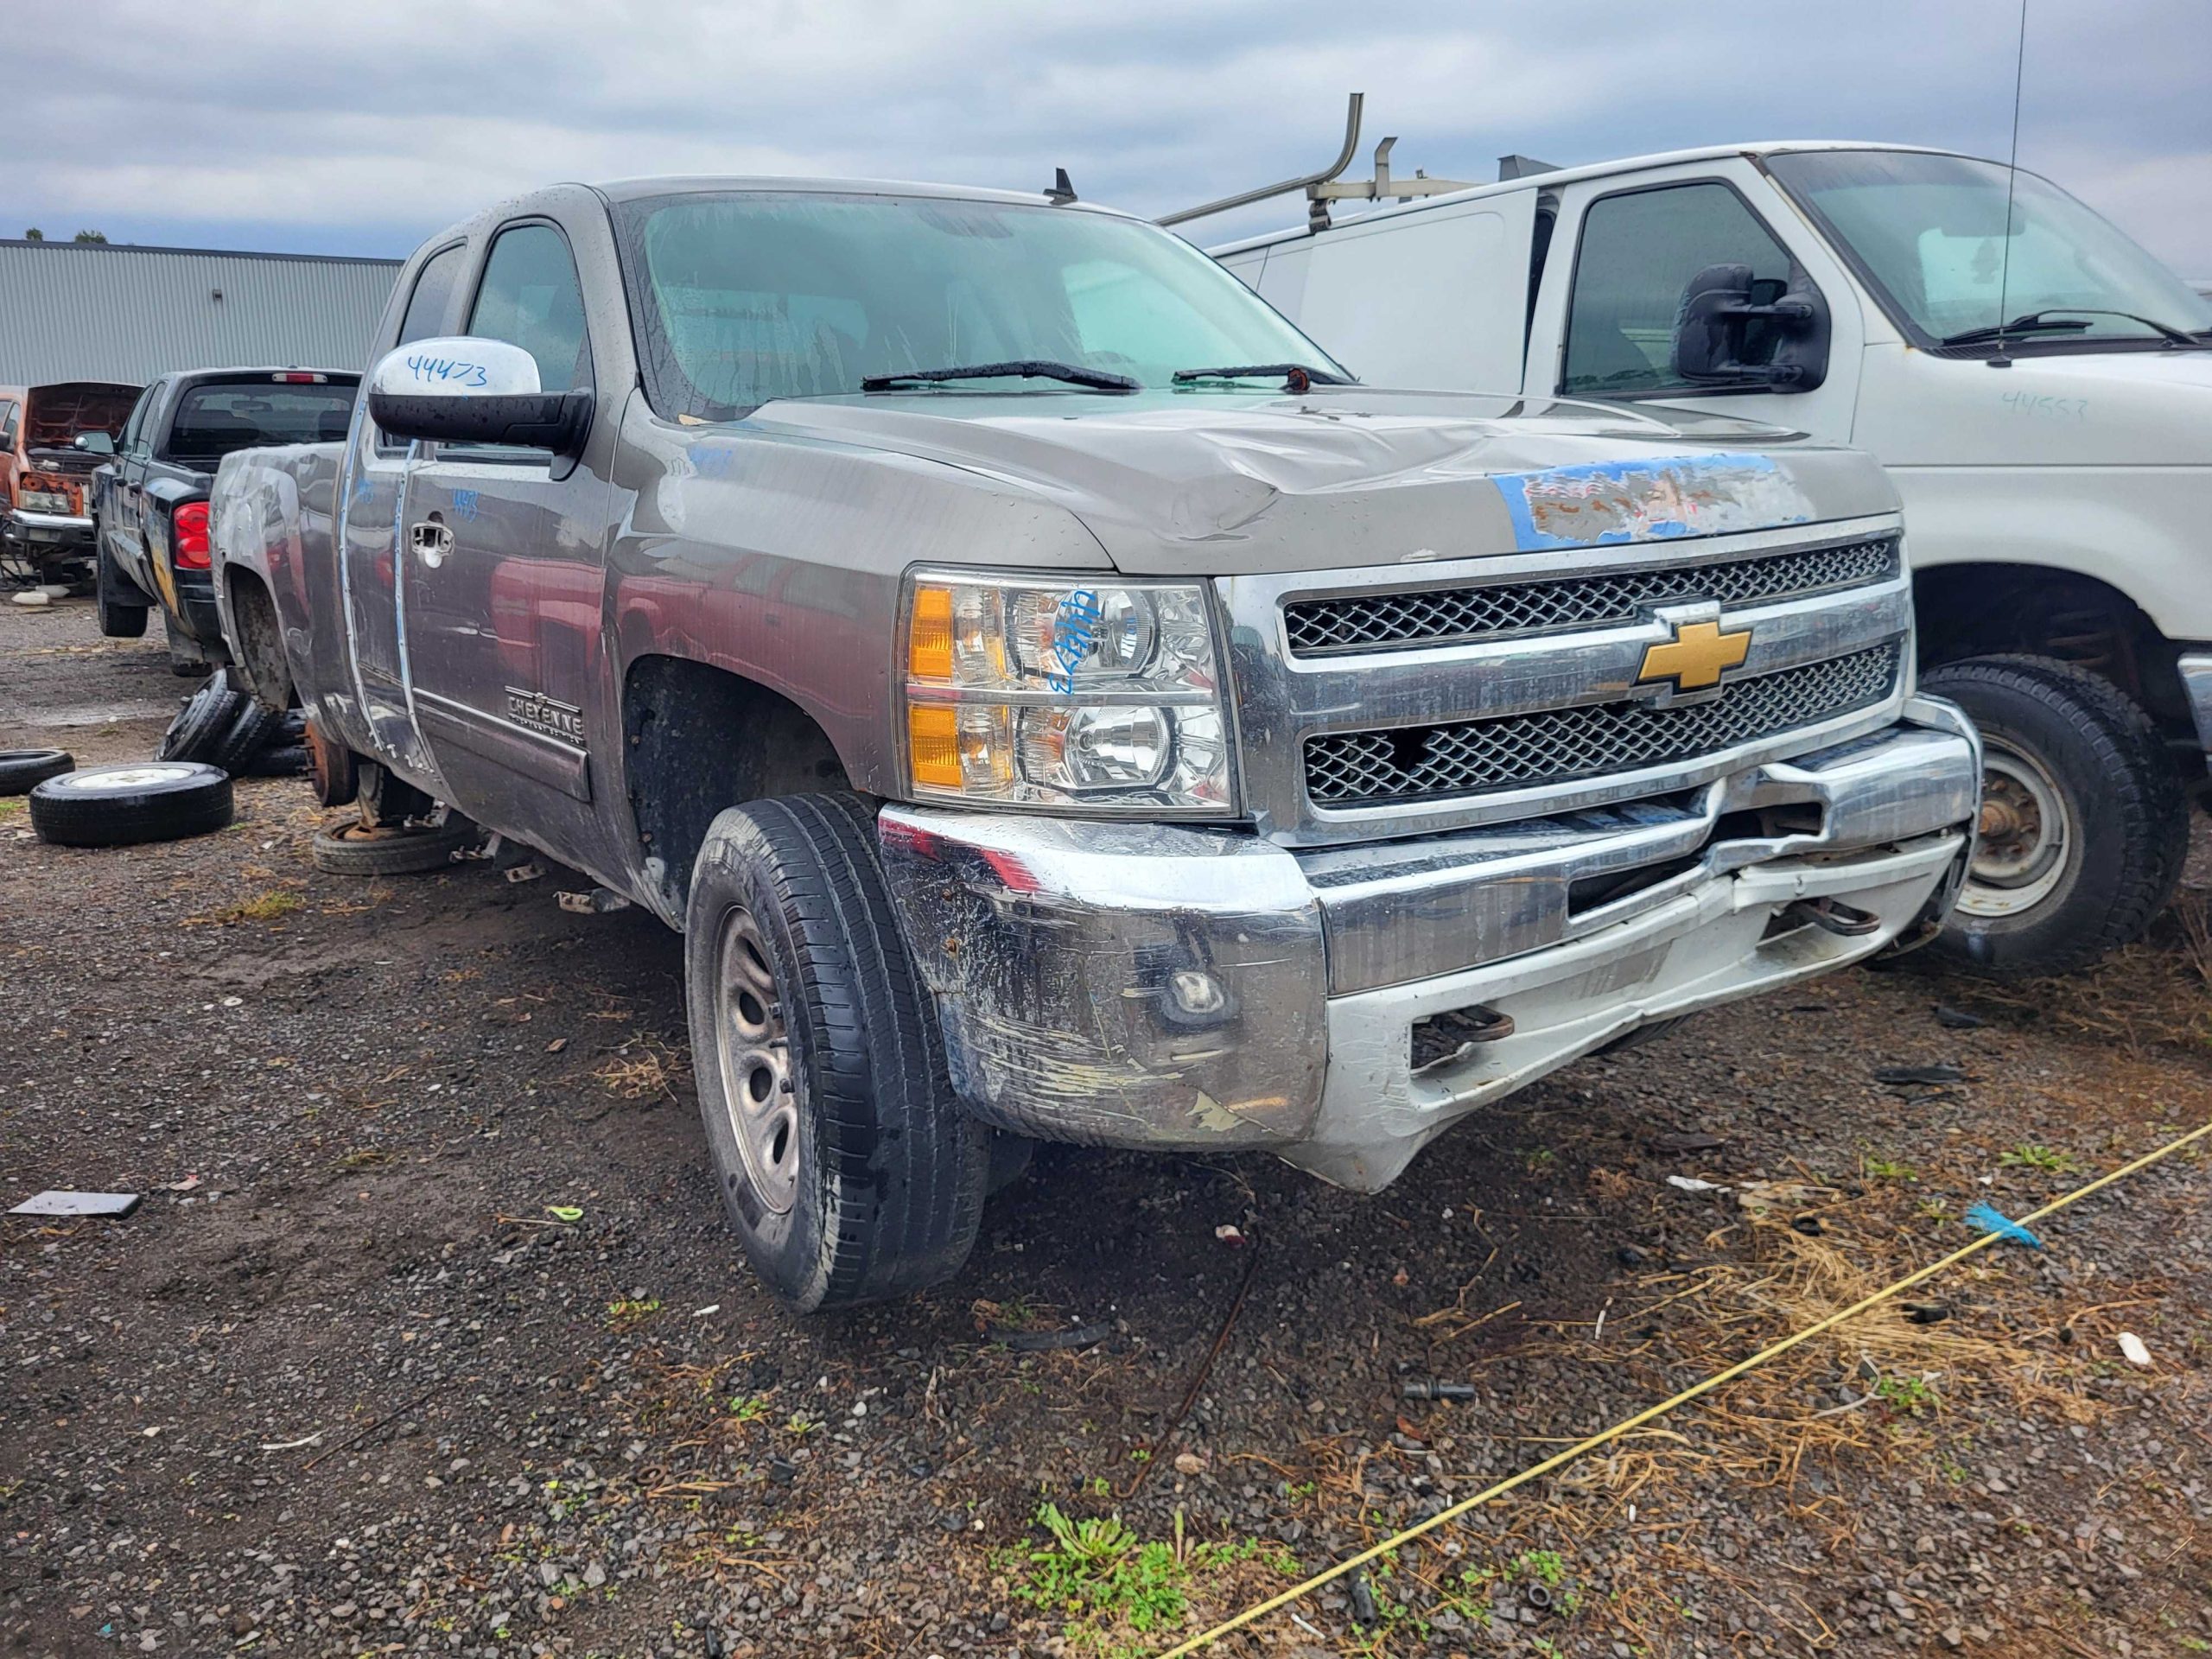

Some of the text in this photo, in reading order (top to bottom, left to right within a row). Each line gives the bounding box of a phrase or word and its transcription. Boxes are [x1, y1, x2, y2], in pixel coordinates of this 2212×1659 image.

[408, 355, 487, 386] 44473
[1049, 590, 1101, 694] 44473
[509, 696, 585, 735] CHEYENNE
